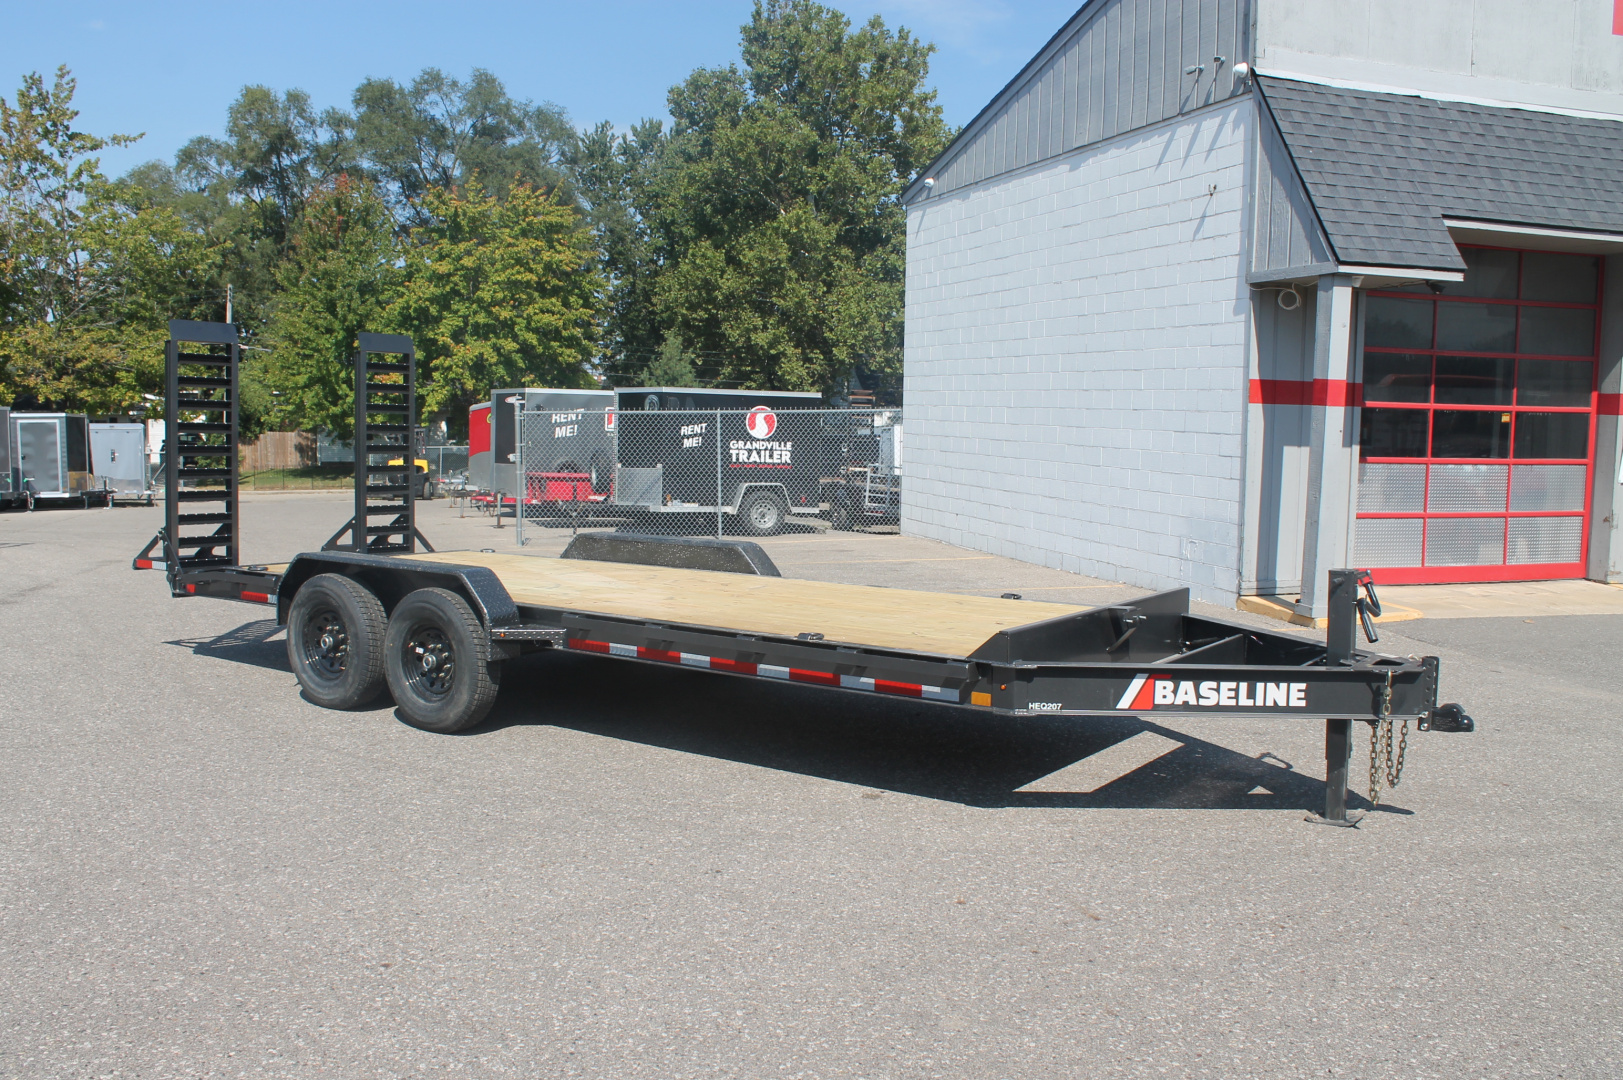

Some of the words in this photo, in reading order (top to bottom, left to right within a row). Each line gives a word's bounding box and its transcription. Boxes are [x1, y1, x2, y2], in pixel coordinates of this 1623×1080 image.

[551, 408, 585, 424] RENT
[554, 424, 578, 439] ME!
[680, 423, 708, 436] RENT
[683, 436, 702, 448] ME!
[729, 440, 792, 451] GRANDVILLE
[729, 449, 791, 464] TRAILER
[1154, 680, 1307, 707] BASELINE
[1028, 702, 1063, 710] HEQ207
